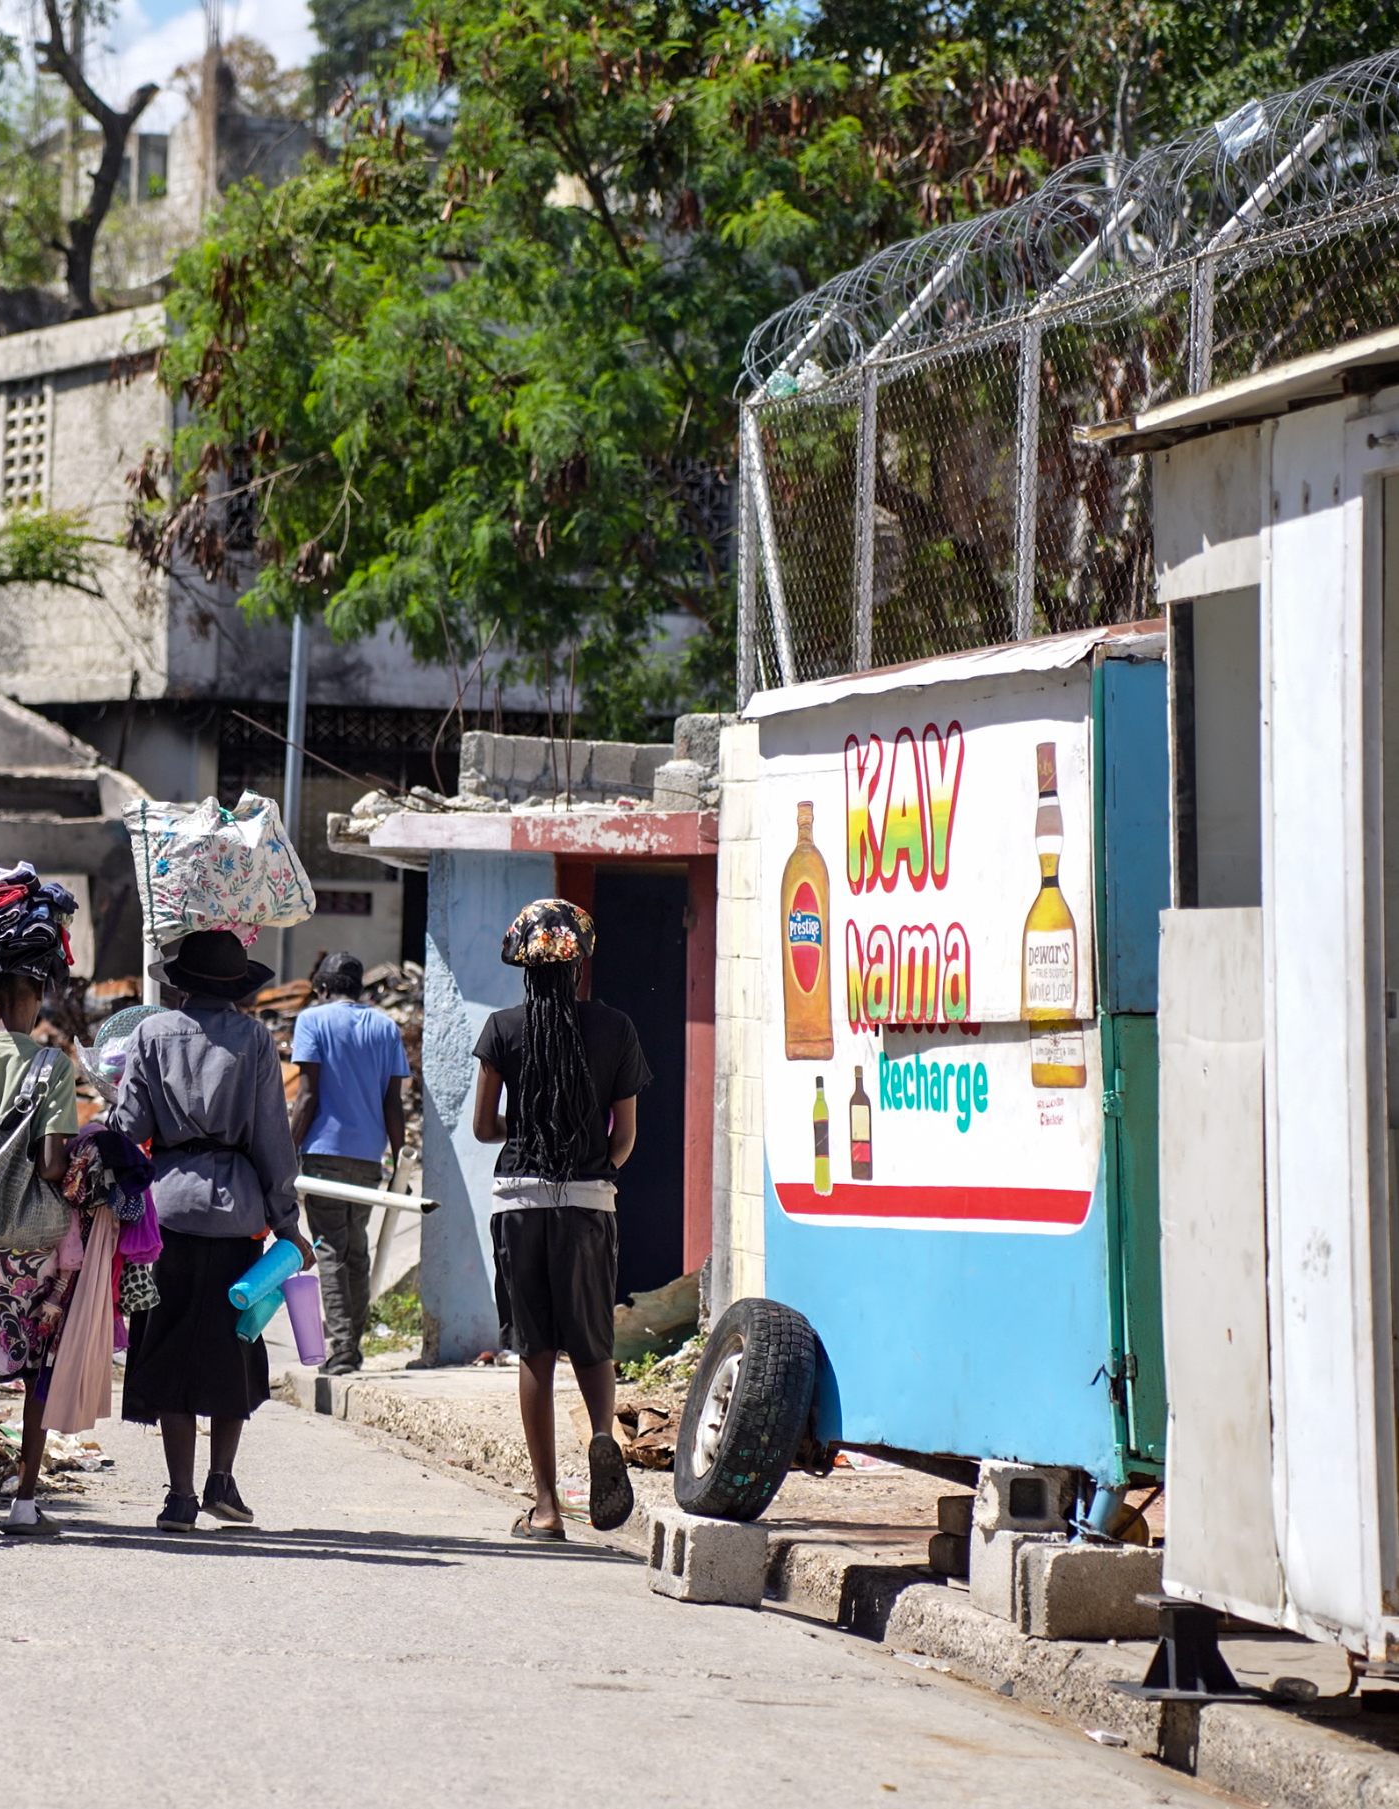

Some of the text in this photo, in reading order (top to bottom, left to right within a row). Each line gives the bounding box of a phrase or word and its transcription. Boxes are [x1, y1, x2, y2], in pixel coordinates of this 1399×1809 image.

[844, 719, 965, 896] KAY
[789, 917, 820, 942] Prestige
[879, 1051, 989, 1133] Recharge
